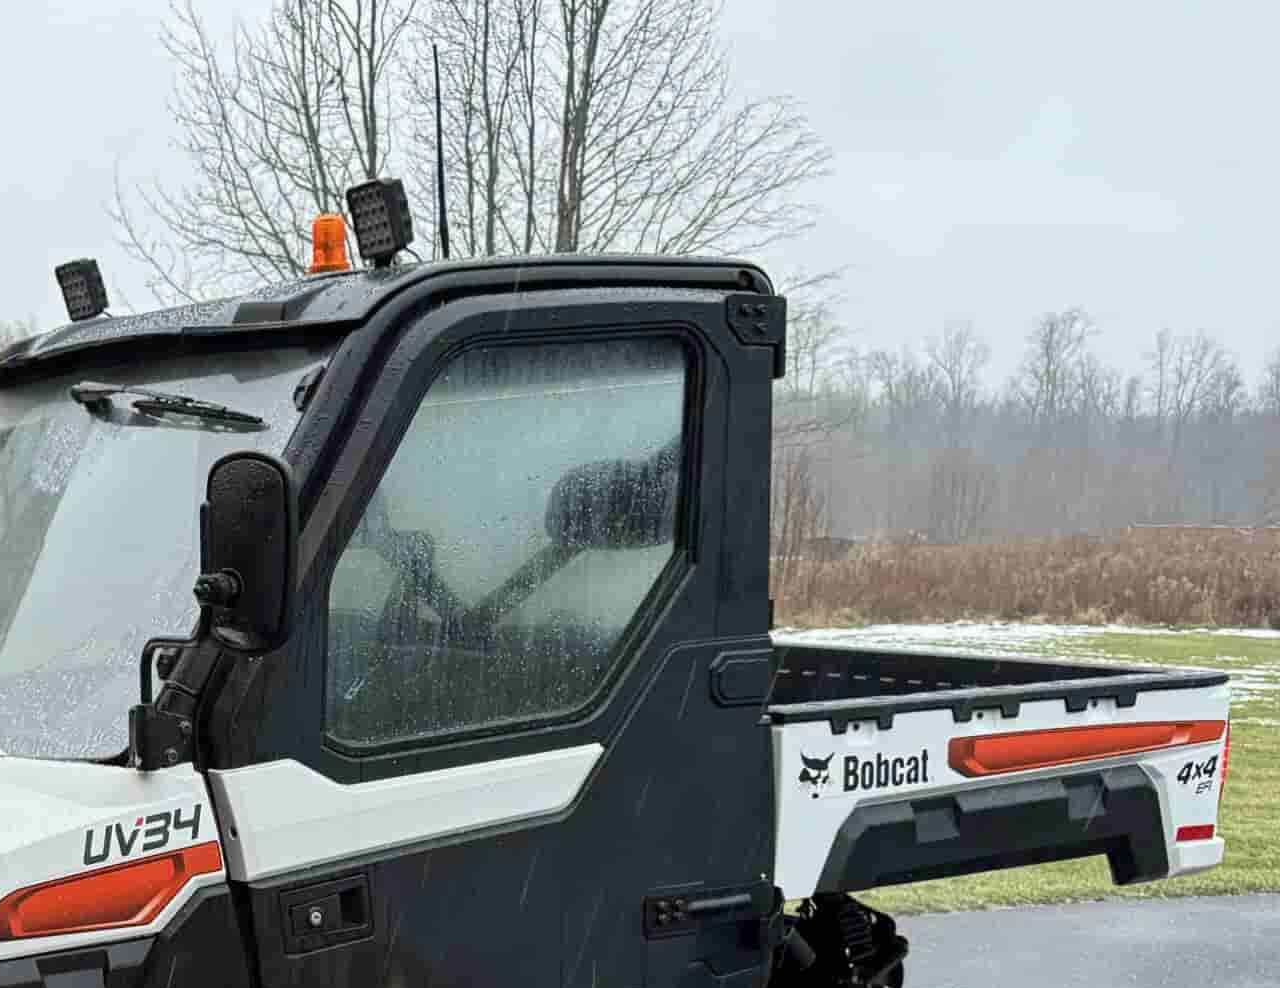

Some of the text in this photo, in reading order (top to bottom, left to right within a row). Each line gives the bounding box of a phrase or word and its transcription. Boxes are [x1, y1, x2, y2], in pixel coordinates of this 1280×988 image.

[843, 749, 929, 792] Bobcat
[1177, 755, 1218, 784] 4x4
[83, 804, 201, 865] UV34
